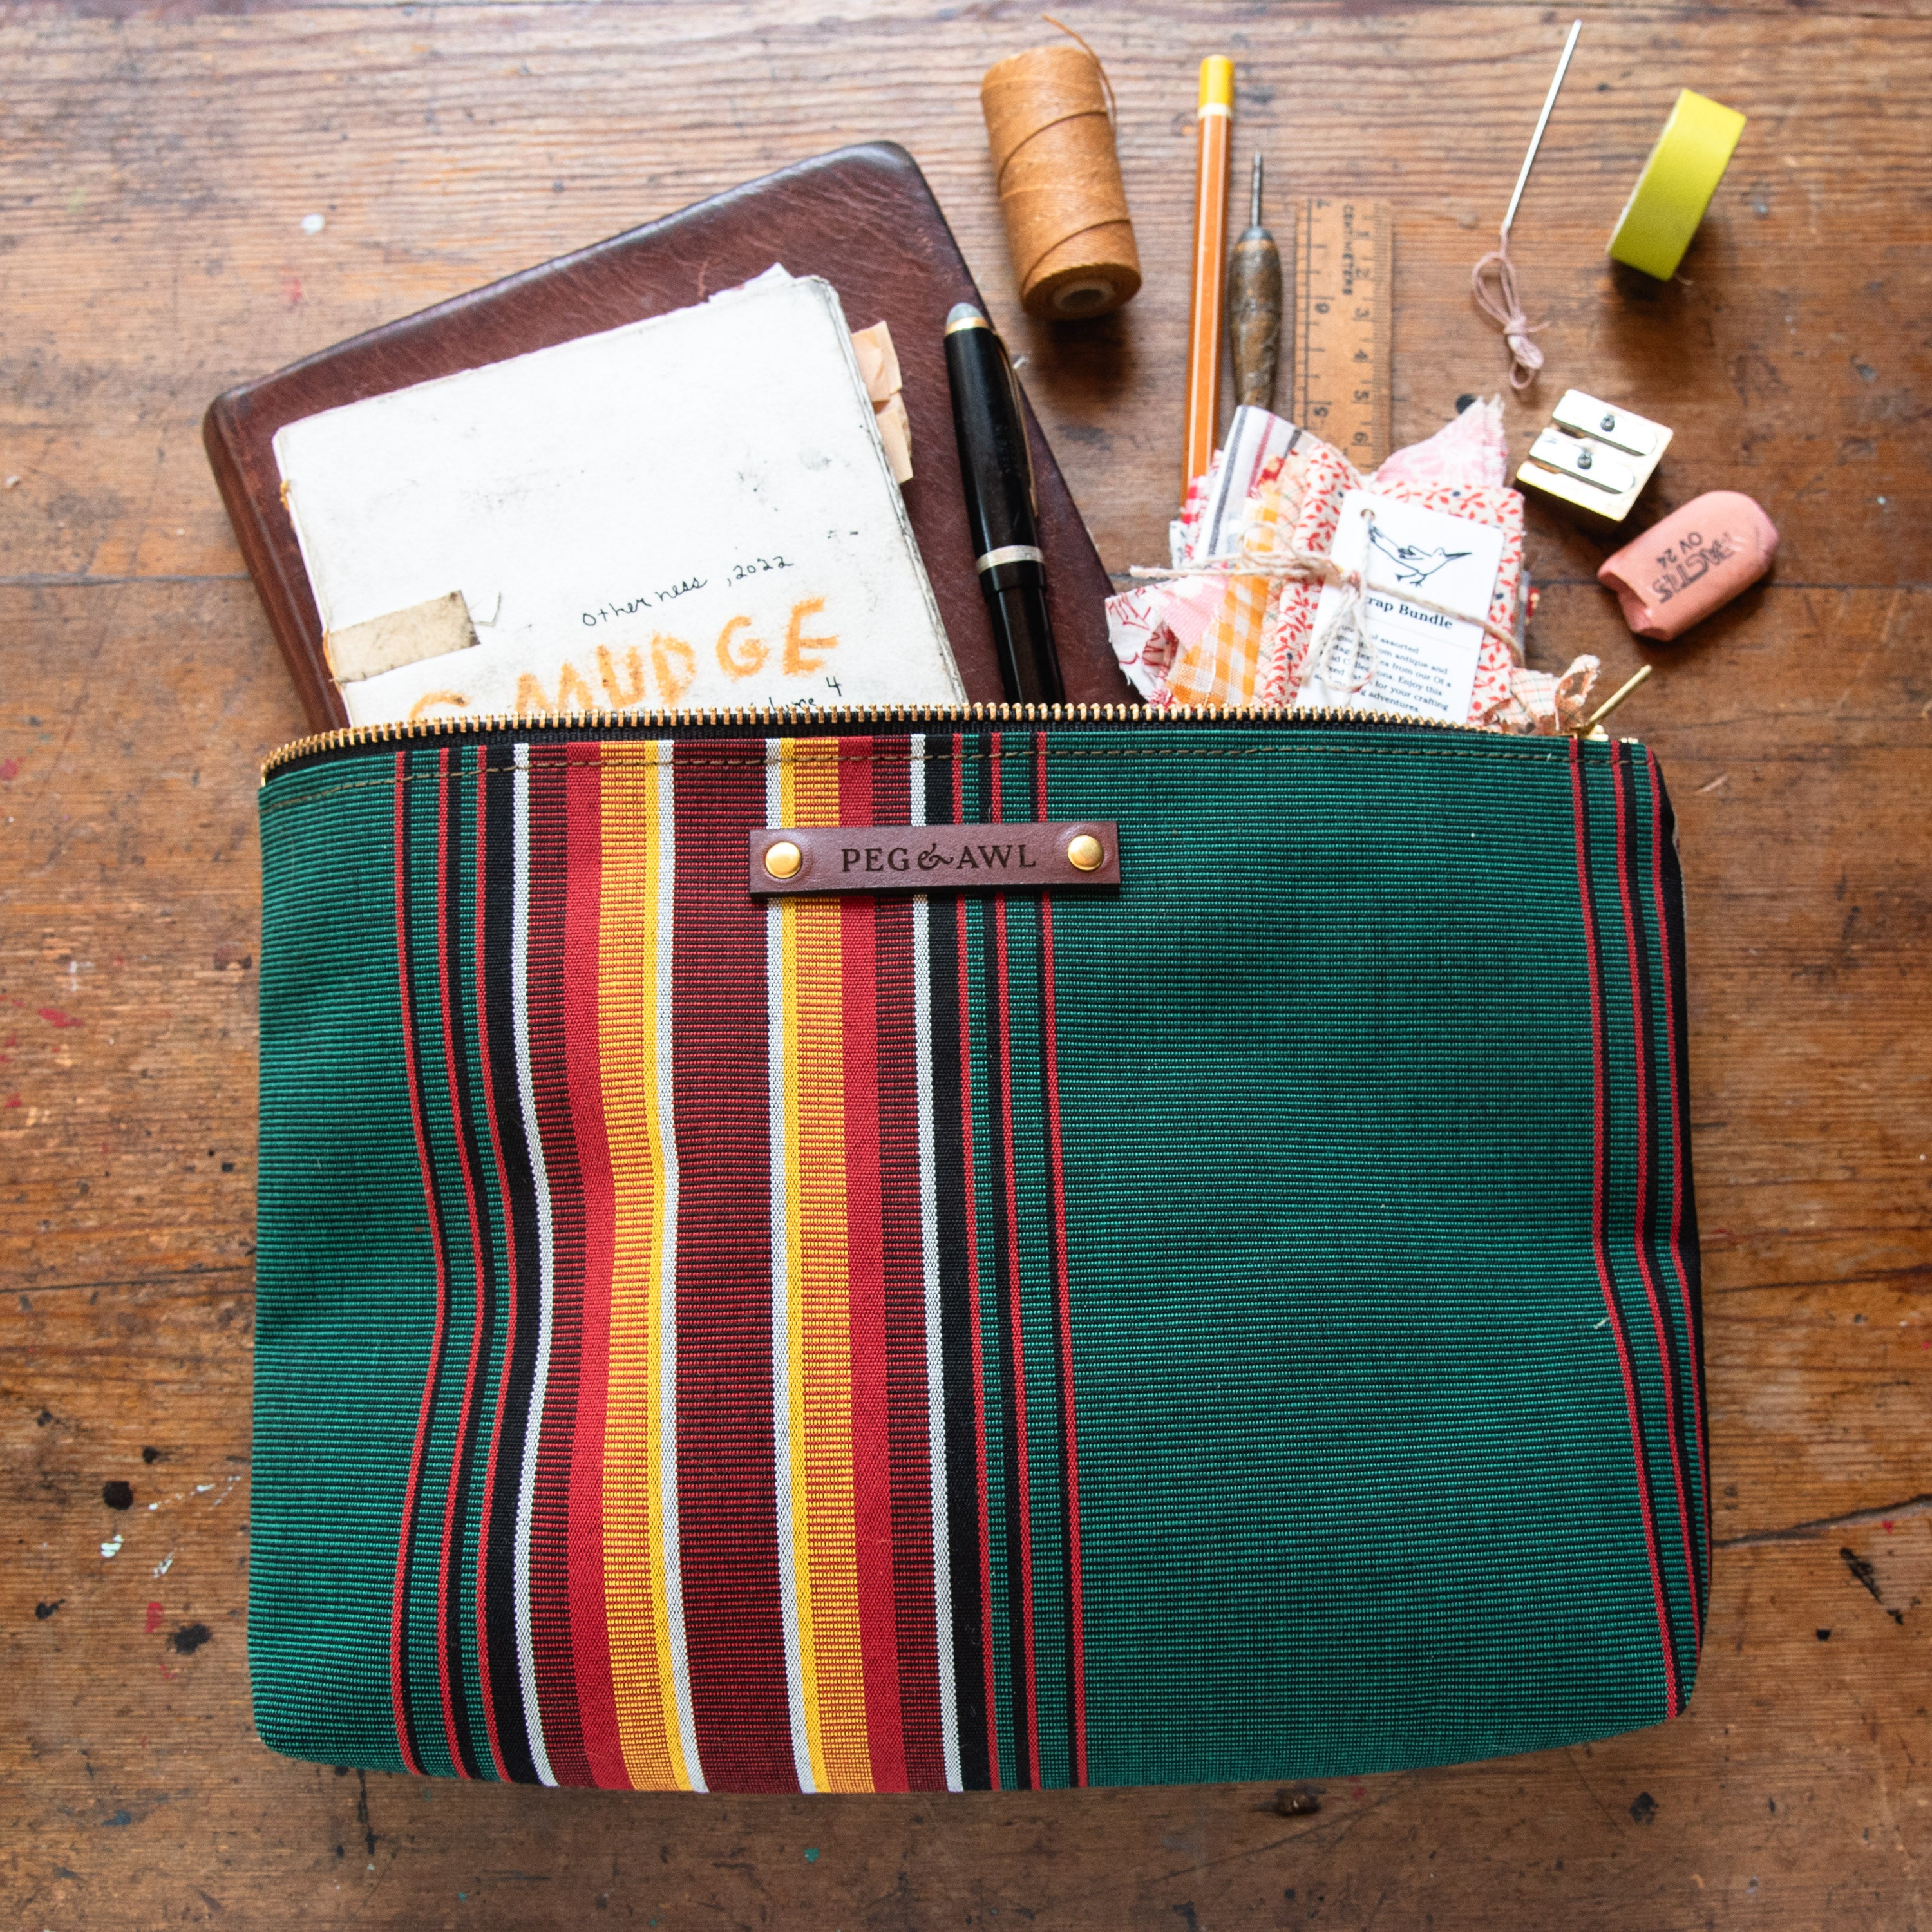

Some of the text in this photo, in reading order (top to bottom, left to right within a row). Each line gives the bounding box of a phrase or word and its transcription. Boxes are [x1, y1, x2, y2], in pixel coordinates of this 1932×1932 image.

[1356, 307, 1370, 317] 3
[1354, 349, 1368, 359] 4
[1354, 390, 1369, 401] 5
[1354, 431, 1368, 443] 6
[1656, 531, 1703, 568] OV 24
[1365, 594, 1453, 629] rap Bundle
[1379, 636, 1419, 653] assorted
[1391, 663, 1414, 674] from
[1416, 672, 1430, 680] our
[1394, 652, 1428, 669] antique
[1430, 665, 1448, 674] and
[826, 677, 842, 697] 4
[1397, 676, 1423, 690] Enjoy
[1425, 686, 1443, 696] this
[1389, 687, 1410, 699] your
[1412, 693, 1448, 711] crafting
